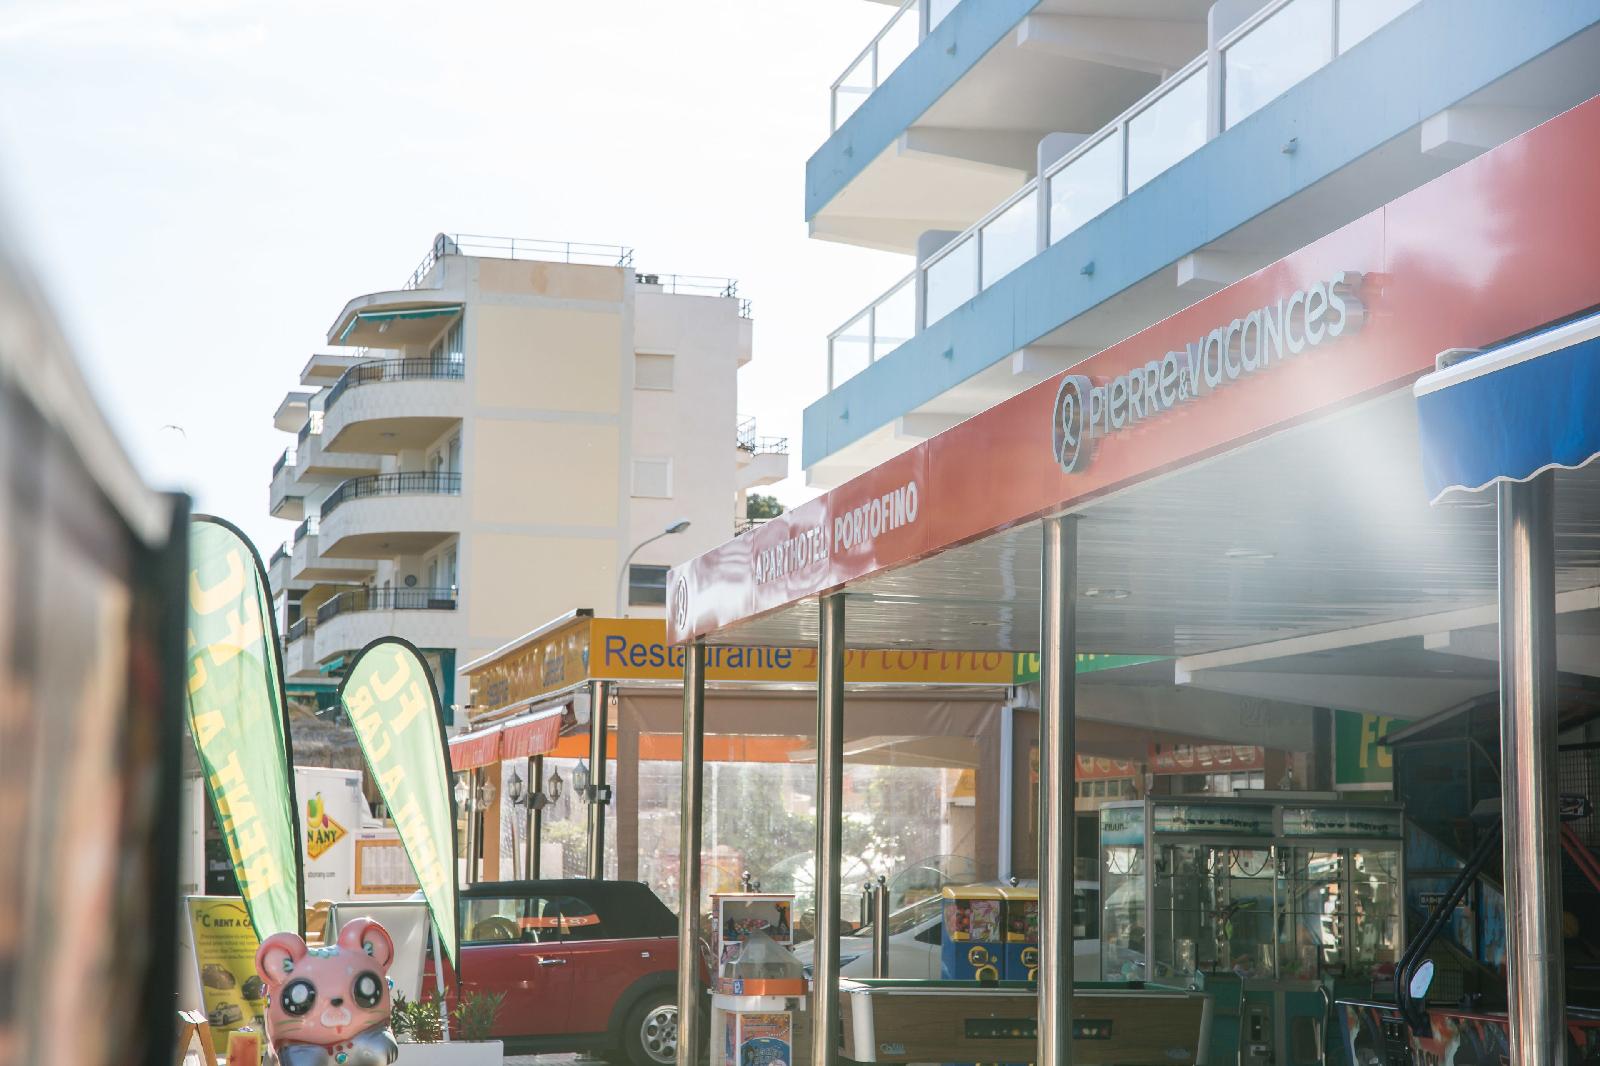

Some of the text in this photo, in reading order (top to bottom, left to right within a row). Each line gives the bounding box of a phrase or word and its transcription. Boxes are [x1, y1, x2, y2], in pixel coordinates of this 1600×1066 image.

[755, 481, 918, 584] APARTHOTEL PORTOFINO
[317, 829, 336, 844] ANY
[214, 918, 233, 927] RENT
[236, 918, 242, 927] A
